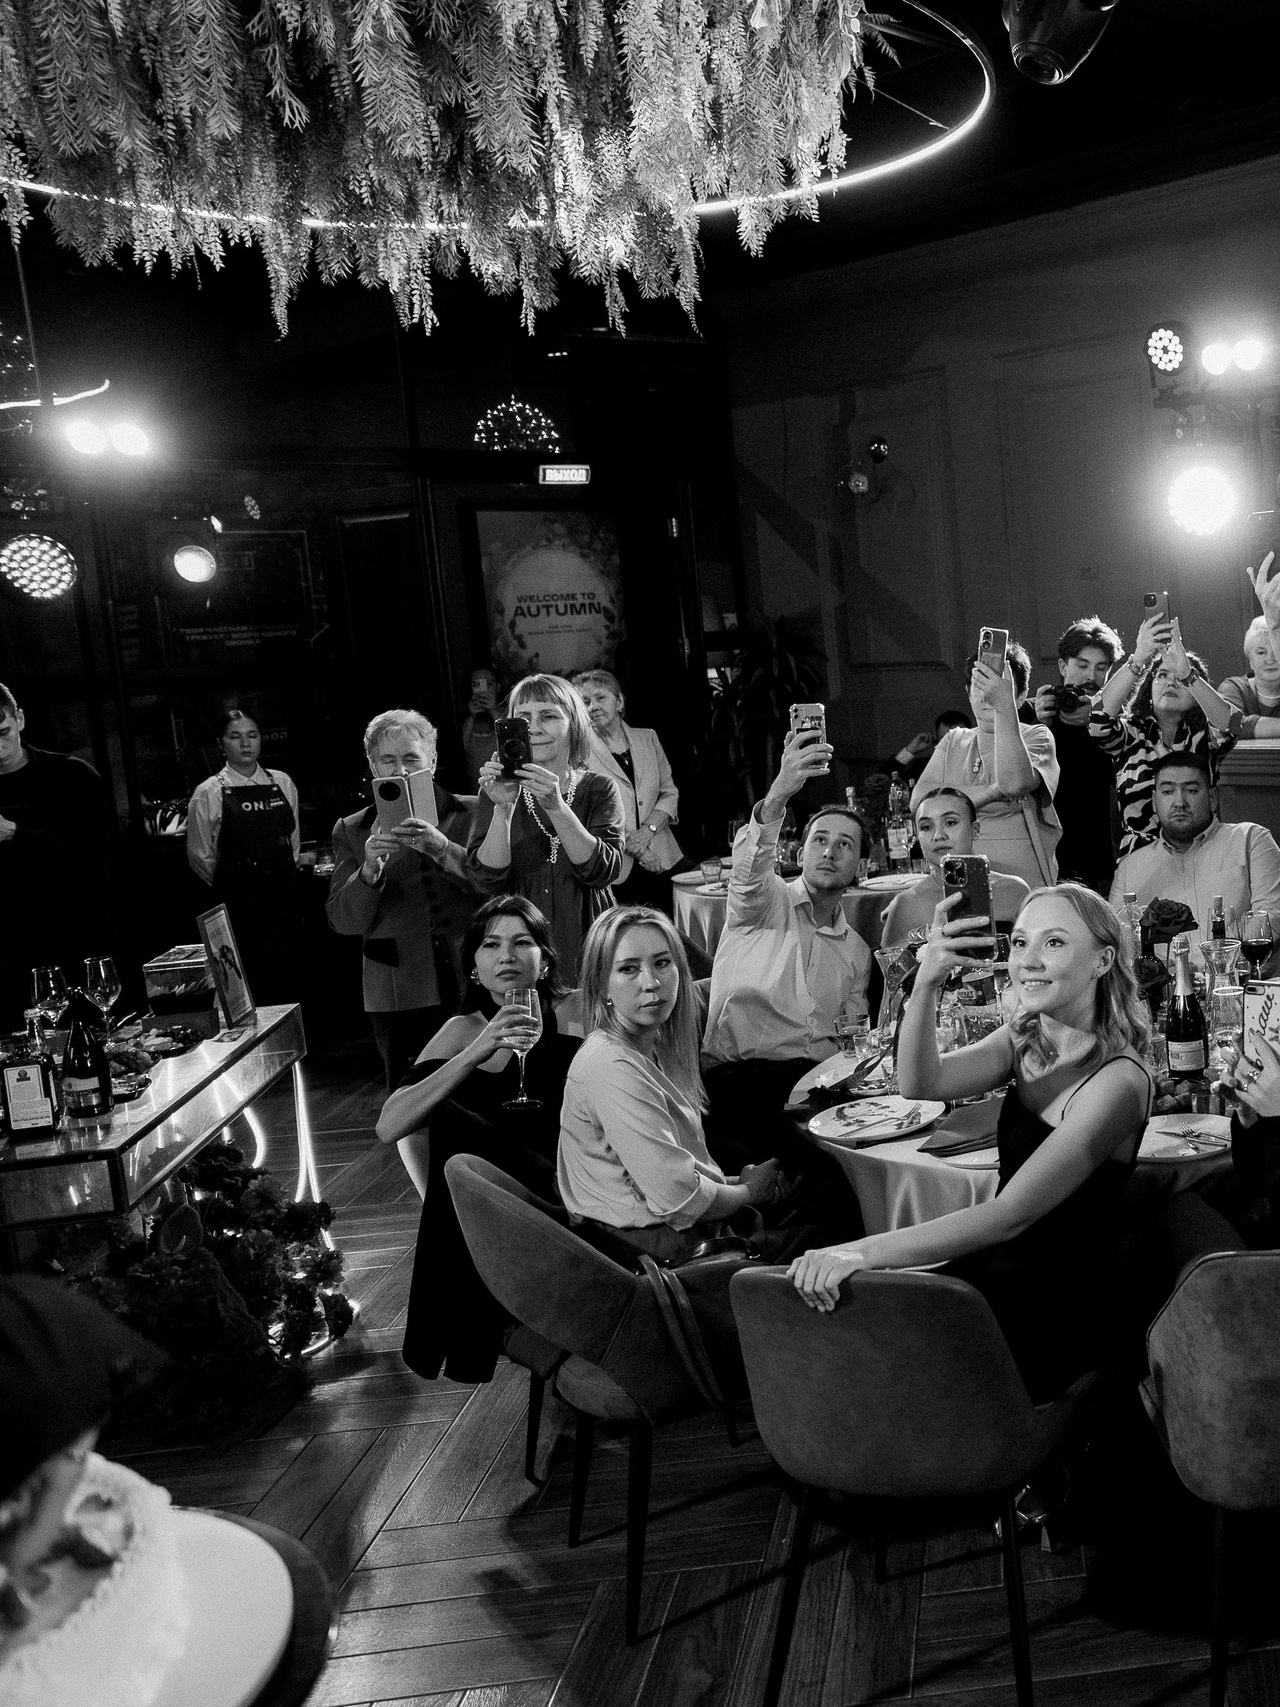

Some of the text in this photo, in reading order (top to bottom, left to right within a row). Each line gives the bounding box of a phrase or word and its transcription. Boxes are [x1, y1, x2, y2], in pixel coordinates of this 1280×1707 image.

[545, 469, 587, 482] ВЫХОД
[516, 592, 596, 604] WELCOME TO
[514, 602, 602, 618] AUTUMN
